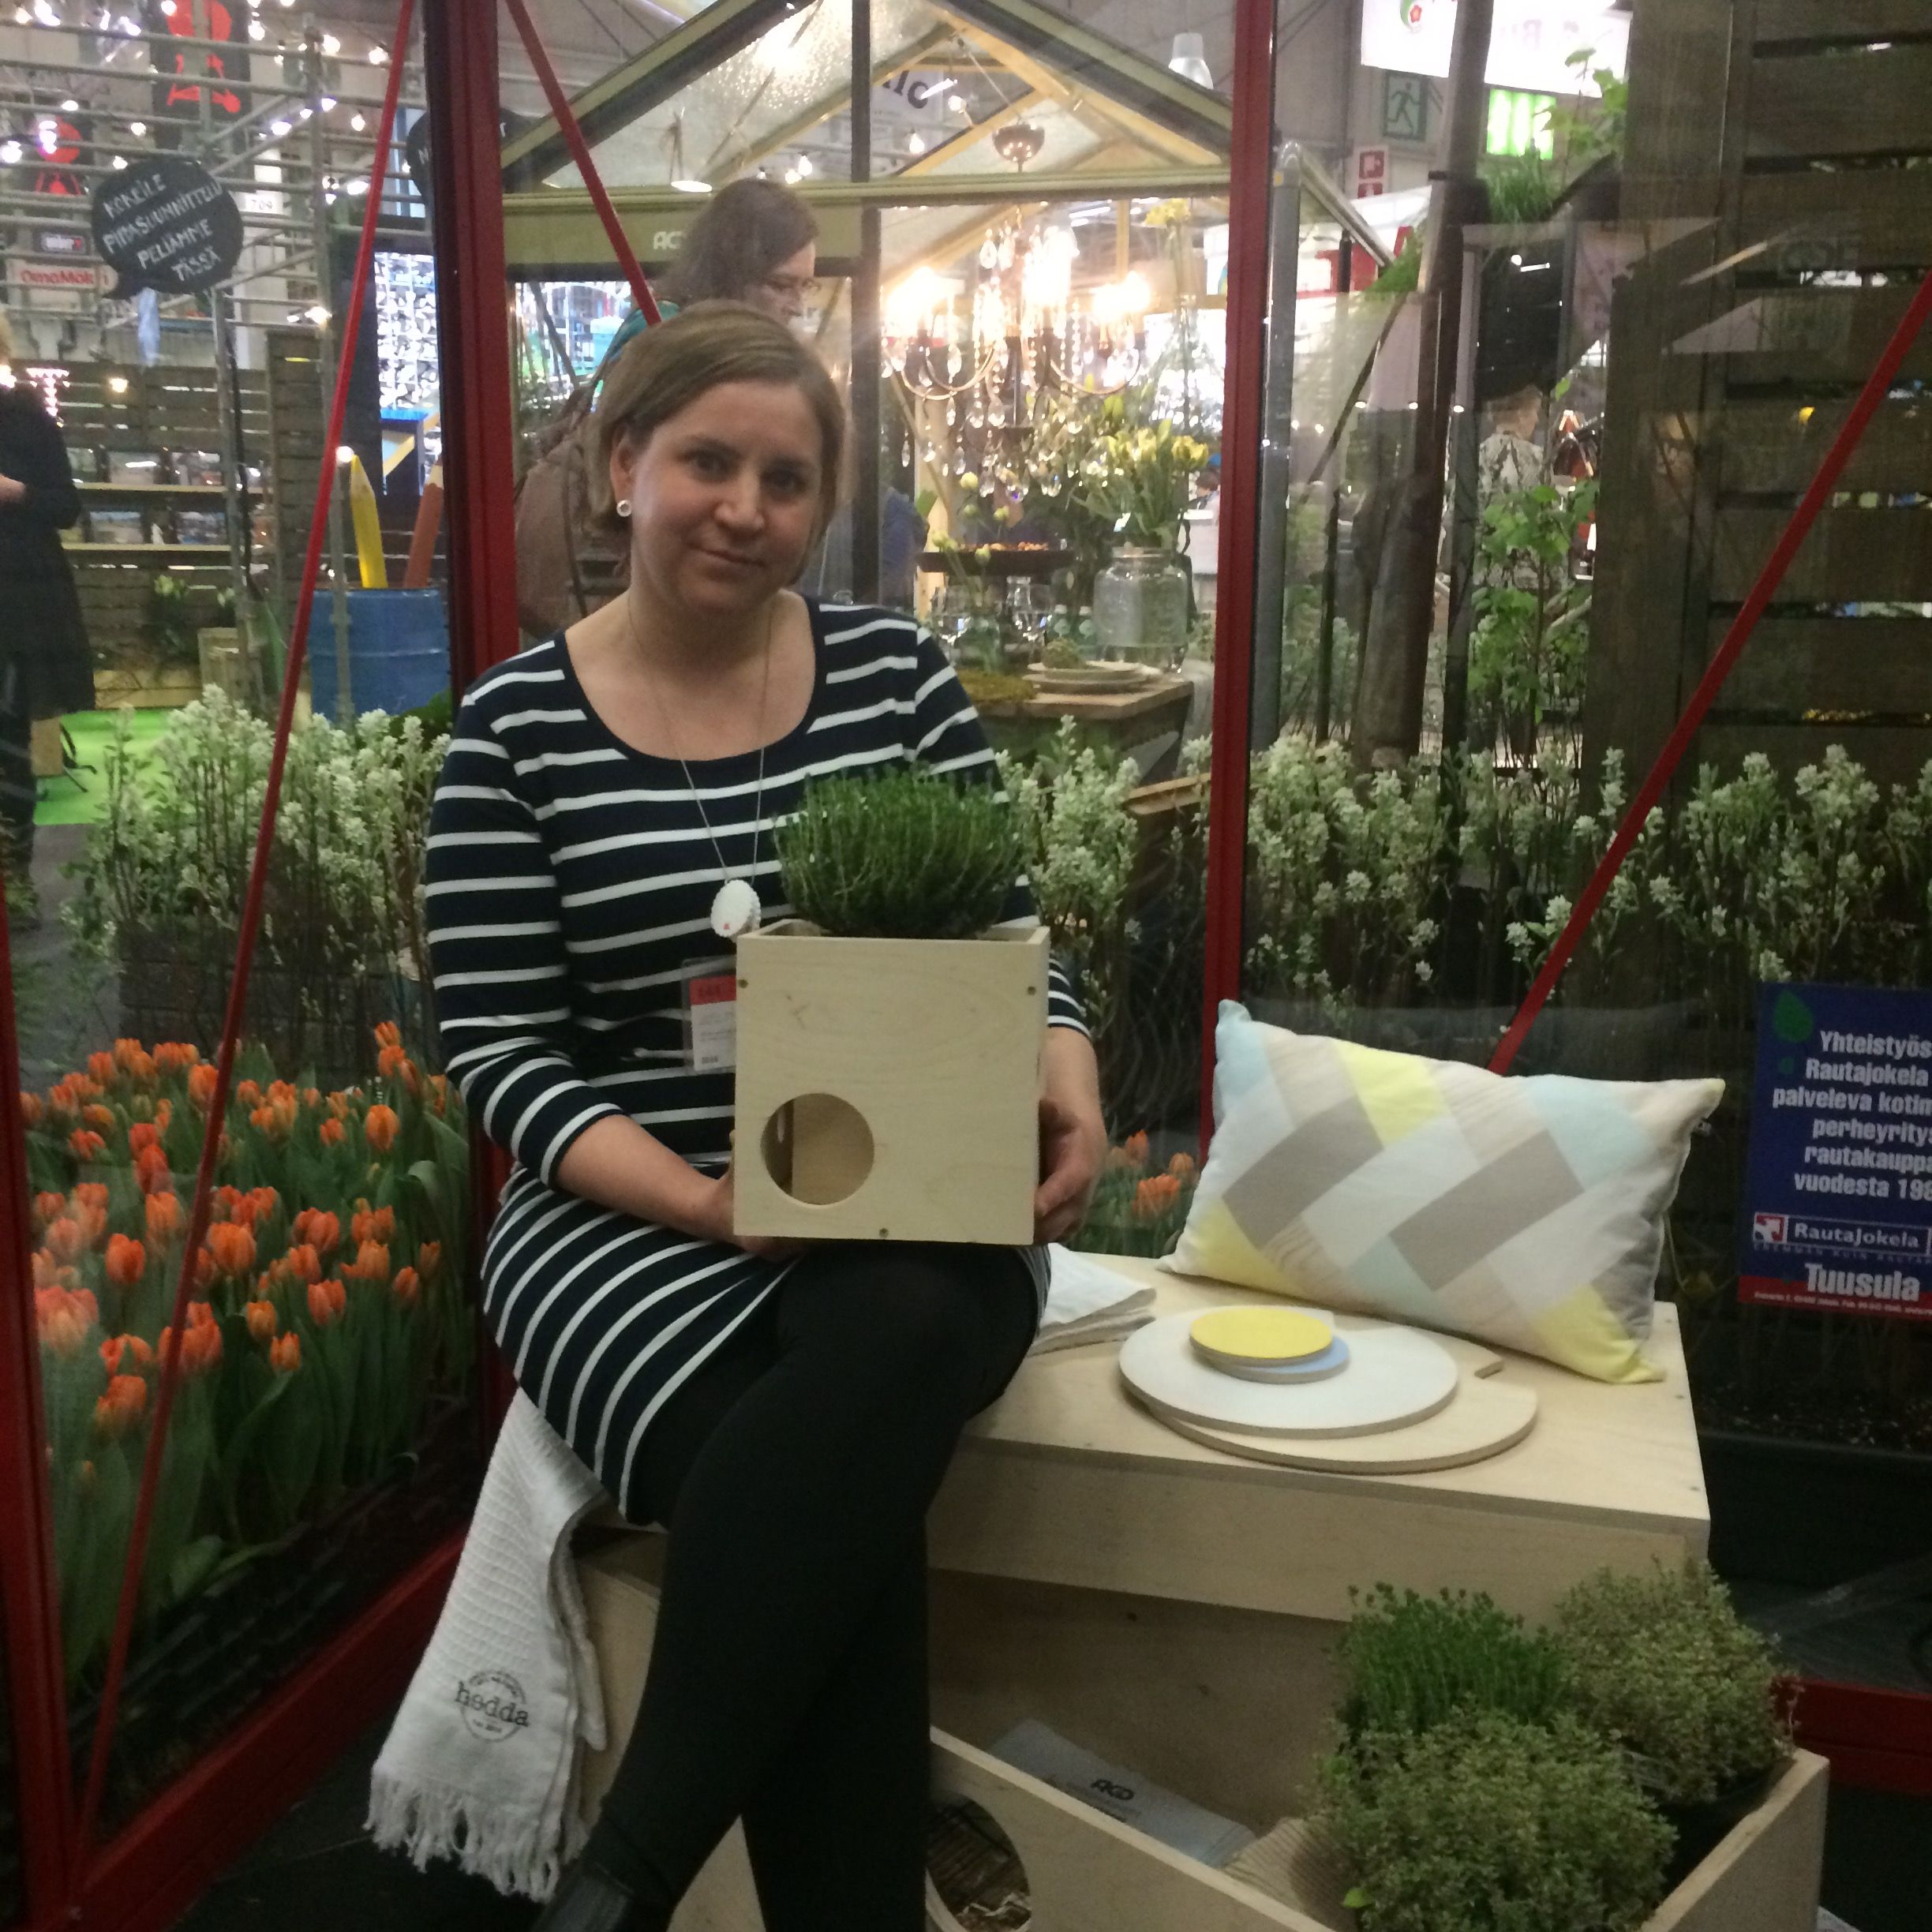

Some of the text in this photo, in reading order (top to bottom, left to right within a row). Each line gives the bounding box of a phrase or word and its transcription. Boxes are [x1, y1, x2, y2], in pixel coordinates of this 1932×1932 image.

[653, 230, 687, 250] AC
[1819, 1029, 1932, 1061] Yhteistyös
[1806, 1057, 1929, 1087] Rautajokela
[1773, 1085, 1873, 1112] palveleva
[1794, 1172, 1890, 1198] vuodesta
[1804, 1262, 1920, 1302] Tuusula
